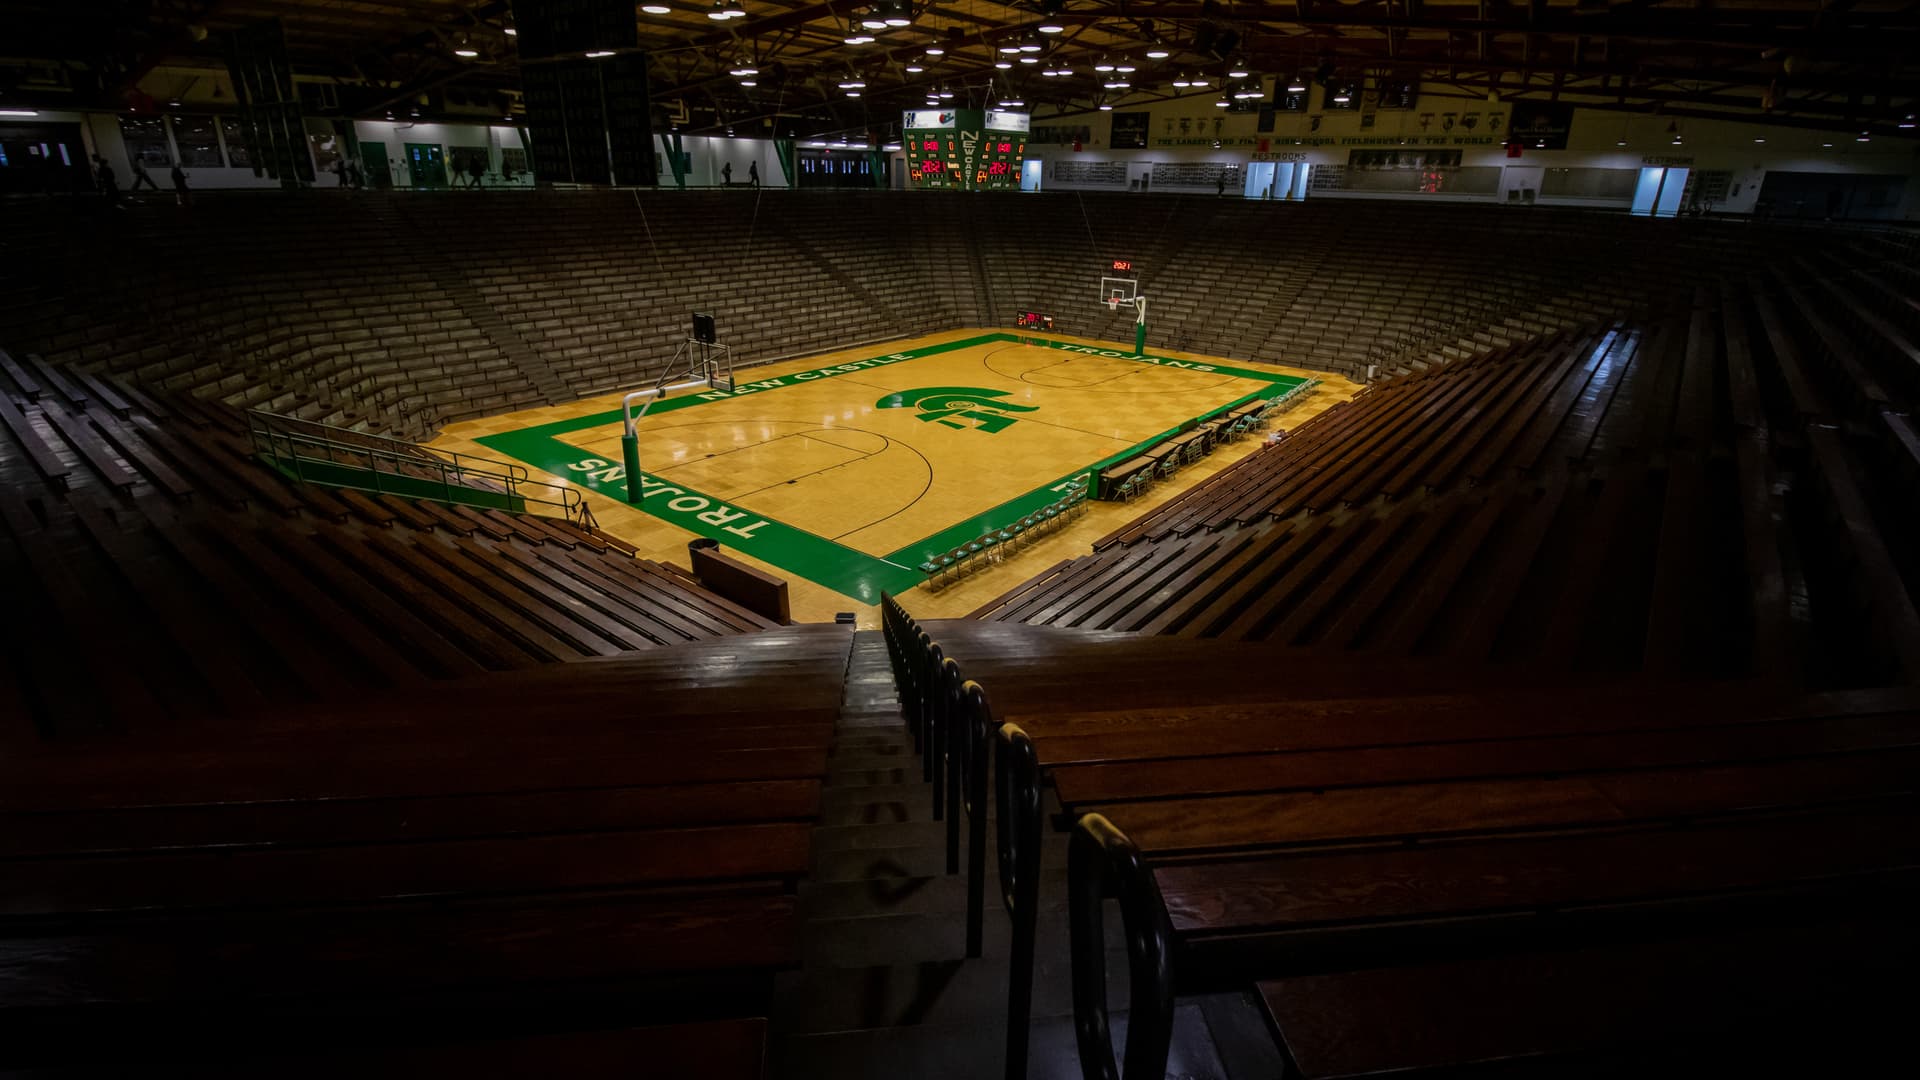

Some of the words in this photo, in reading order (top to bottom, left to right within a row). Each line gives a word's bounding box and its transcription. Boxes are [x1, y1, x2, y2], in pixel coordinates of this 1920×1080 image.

[1251, 152, 1307, 160] RESTROOMS
[696, 377, 785, 400] NEW
[794, 352, 914, 380] CASTLE
[1060, 344, 1217, 372] TROJANS
[568, 458, 770, 540] TROJANS
